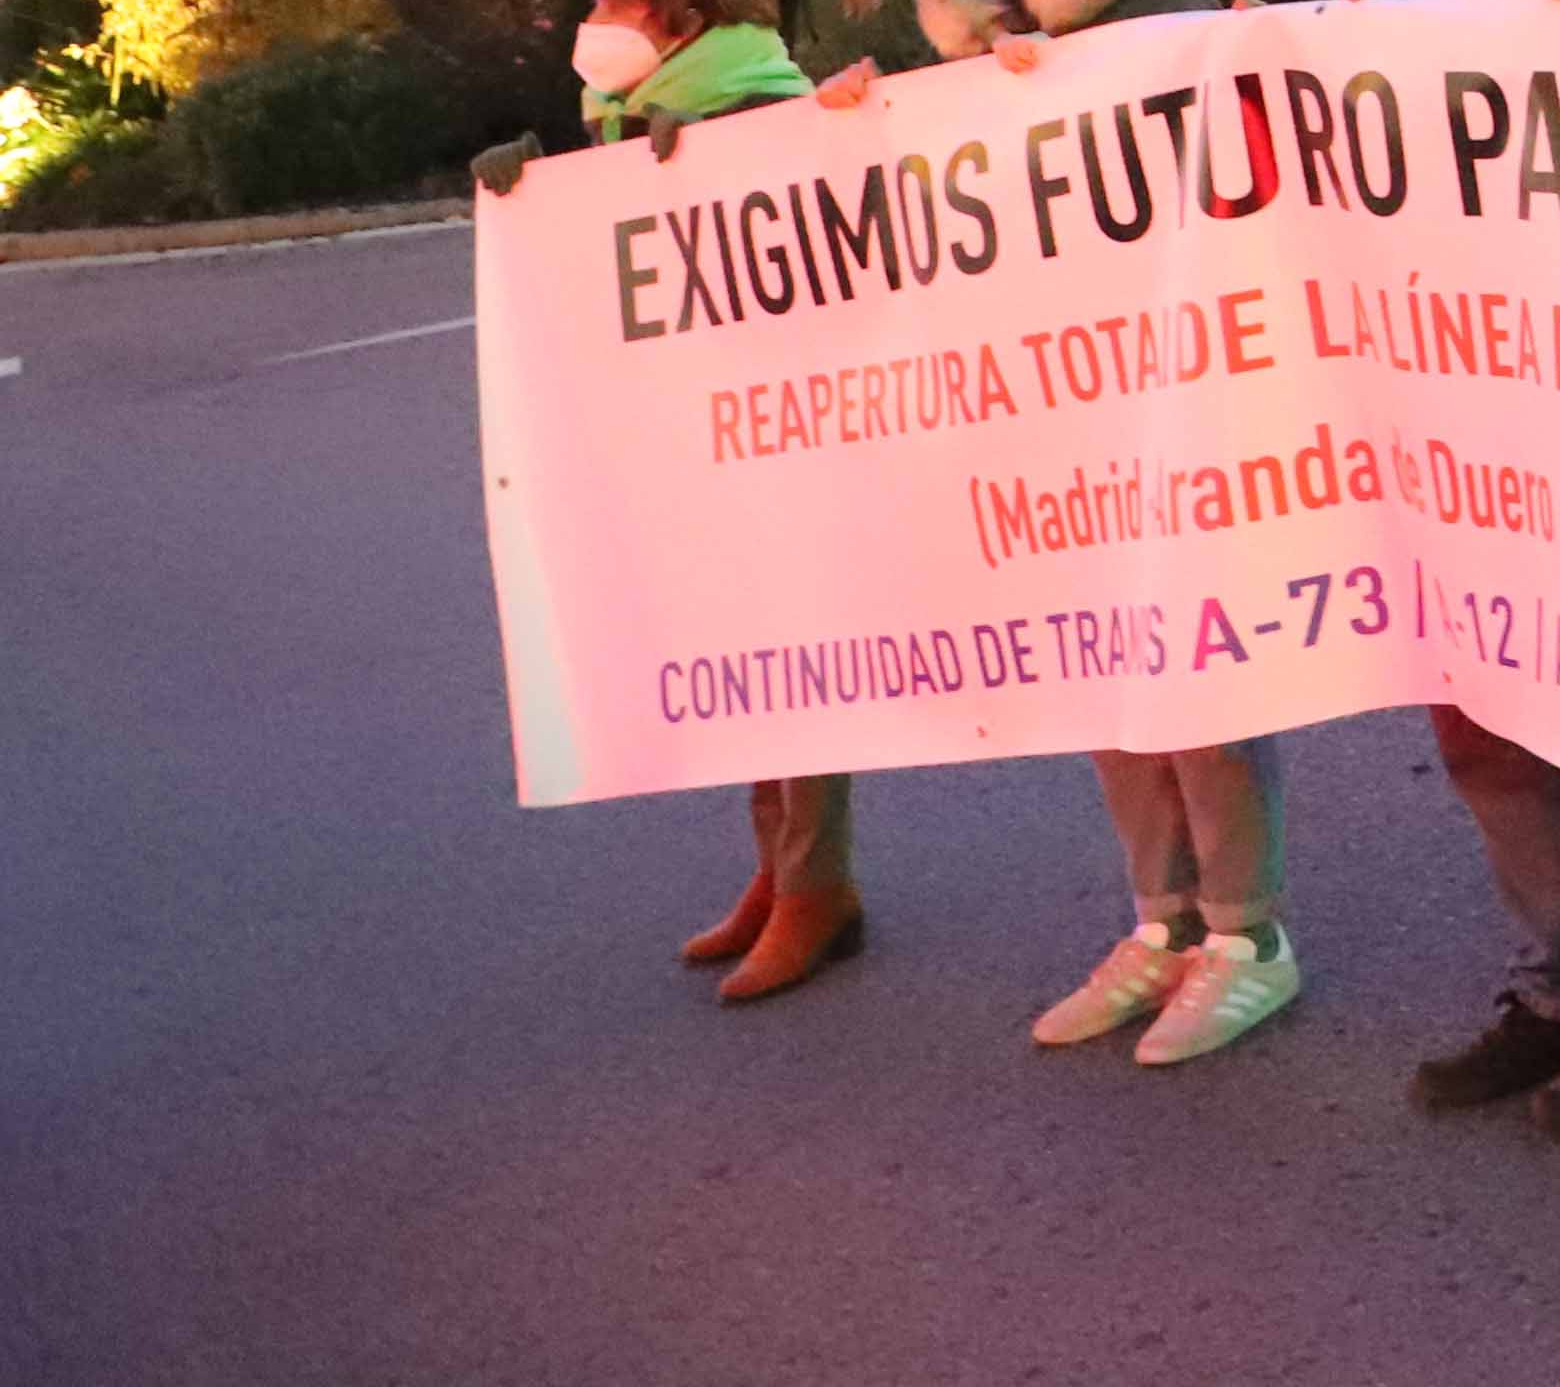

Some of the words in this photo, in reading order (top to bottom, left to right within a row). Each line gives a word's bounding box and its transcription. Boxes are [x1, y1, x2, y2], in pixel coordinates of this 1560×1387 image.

[615, 140, 998, 342] EXIGIMOS
[1026, 69, 1407, 258] FUTURO
[711, 343, 1017, 463] REAPERTURA
[1177, 288, 1274, 383] DE
[1305, 280, 1380, 363] LA
[1376, 271, 1542, 386] LÍNEA
[970, 458, 1142, 569] (Madrid
[1426, 439, 1553, 542] Duero
[660, 629, 962, 723] CONTINUIDAD
[972, 619, 1038, 687] DE
[1192, 566, 1389, 671] A-73
